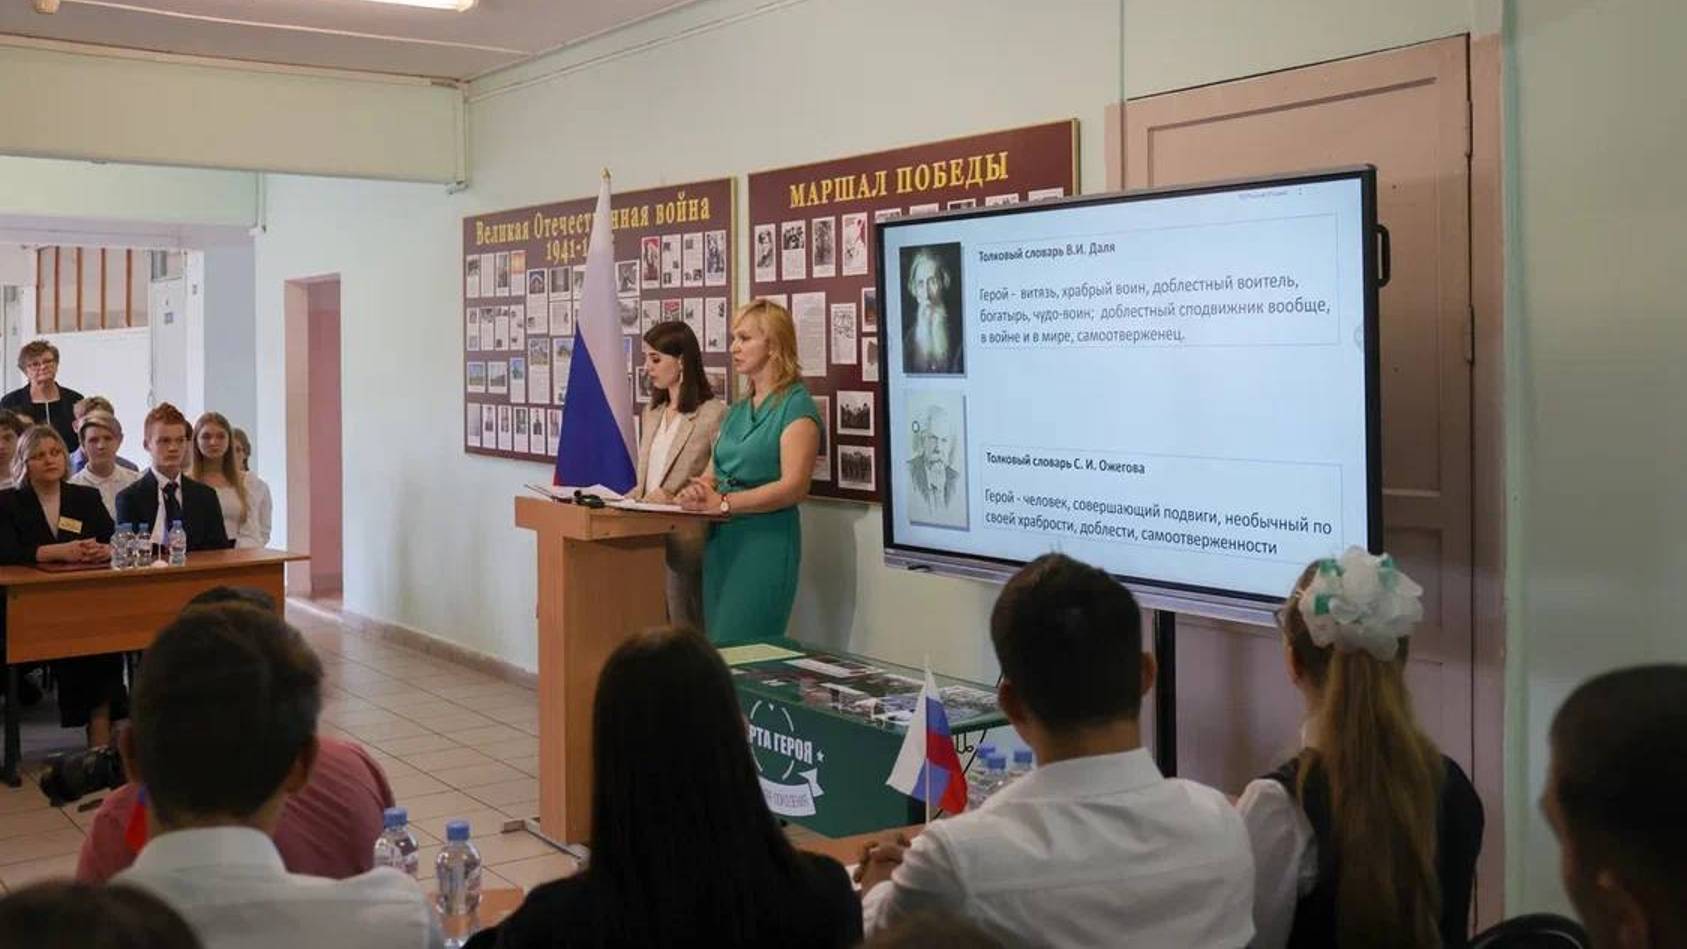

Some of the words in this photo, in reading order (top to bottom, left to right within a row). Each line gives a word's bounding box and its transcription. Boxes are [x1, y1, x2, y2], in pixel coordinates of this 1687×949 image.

[789, 170, 888, 208] МАРШАЛ
[896, 151, 1009, 194] ПОБЕДЫ
[475, 220, 529, 246] Великая
[533, 204, 649, 239] Отечестнная
[655, 191, 711, 225] война
[979, 247, 1023, 262] Толковый
[1024, 246, 1064, 259] словарь
[1065, 243, 1086, 256] В.И.
[1088, 241, 1116, 256] Даля
[979, 286, 1009, 303] Герой
[1020, 287, 1060, 300] витязь,
[1061, 280, 1113, 300] храбрый
[1115, 282, 1150, 297] воин,
[1152, 276, 1234, 296] доблестный
[1236, 274, 1300, 290] воитель,
[980, 308, 1031, 325] богатырь,
[1032, 308, 1095, 324] чудо-воин;
[1101, 302, 1176, 321] доблестный
[1178, 302, 1265, 318] сподвижник
[1267, 296, 1330, 315] вообще,
[980, 332, 988, 343] в
[989, 330, 1021, 344] войне
[1023, 332, 1031, 343] и
[1032, 331, 1040, 343] в
[1041, 331, 1075, 345] мире,
[1076, 328, 1186, 345] самоотверженец.
[985, 451, 1031, 466] Толковый
[1032, 456, 1073, 471] словарь
[1073, 457, 1084, 470] С.
[1085, 459, 1097, 471] И.
[1099, 459, 1146, 475] Ожегова
[984, 488, 1015, 504] Герой
[1022, 494, 1071, 512] человек,
[1072, 498, 1161, 519] совершающий
[1163, 506, 1222, 527] подвиги,
[1225, 512, 1310, 534] необычный
[1313, 520, 1333, 536] по
[985, 511, 1017, 526] своей
[1017, 513, 1078, 535] храбрости,
[1079, 521, 1139, 542] доблести,
[1140, 528, 1279, 555] самоотверженности
[773, 732, 813, 766] ГЕРОЯ
